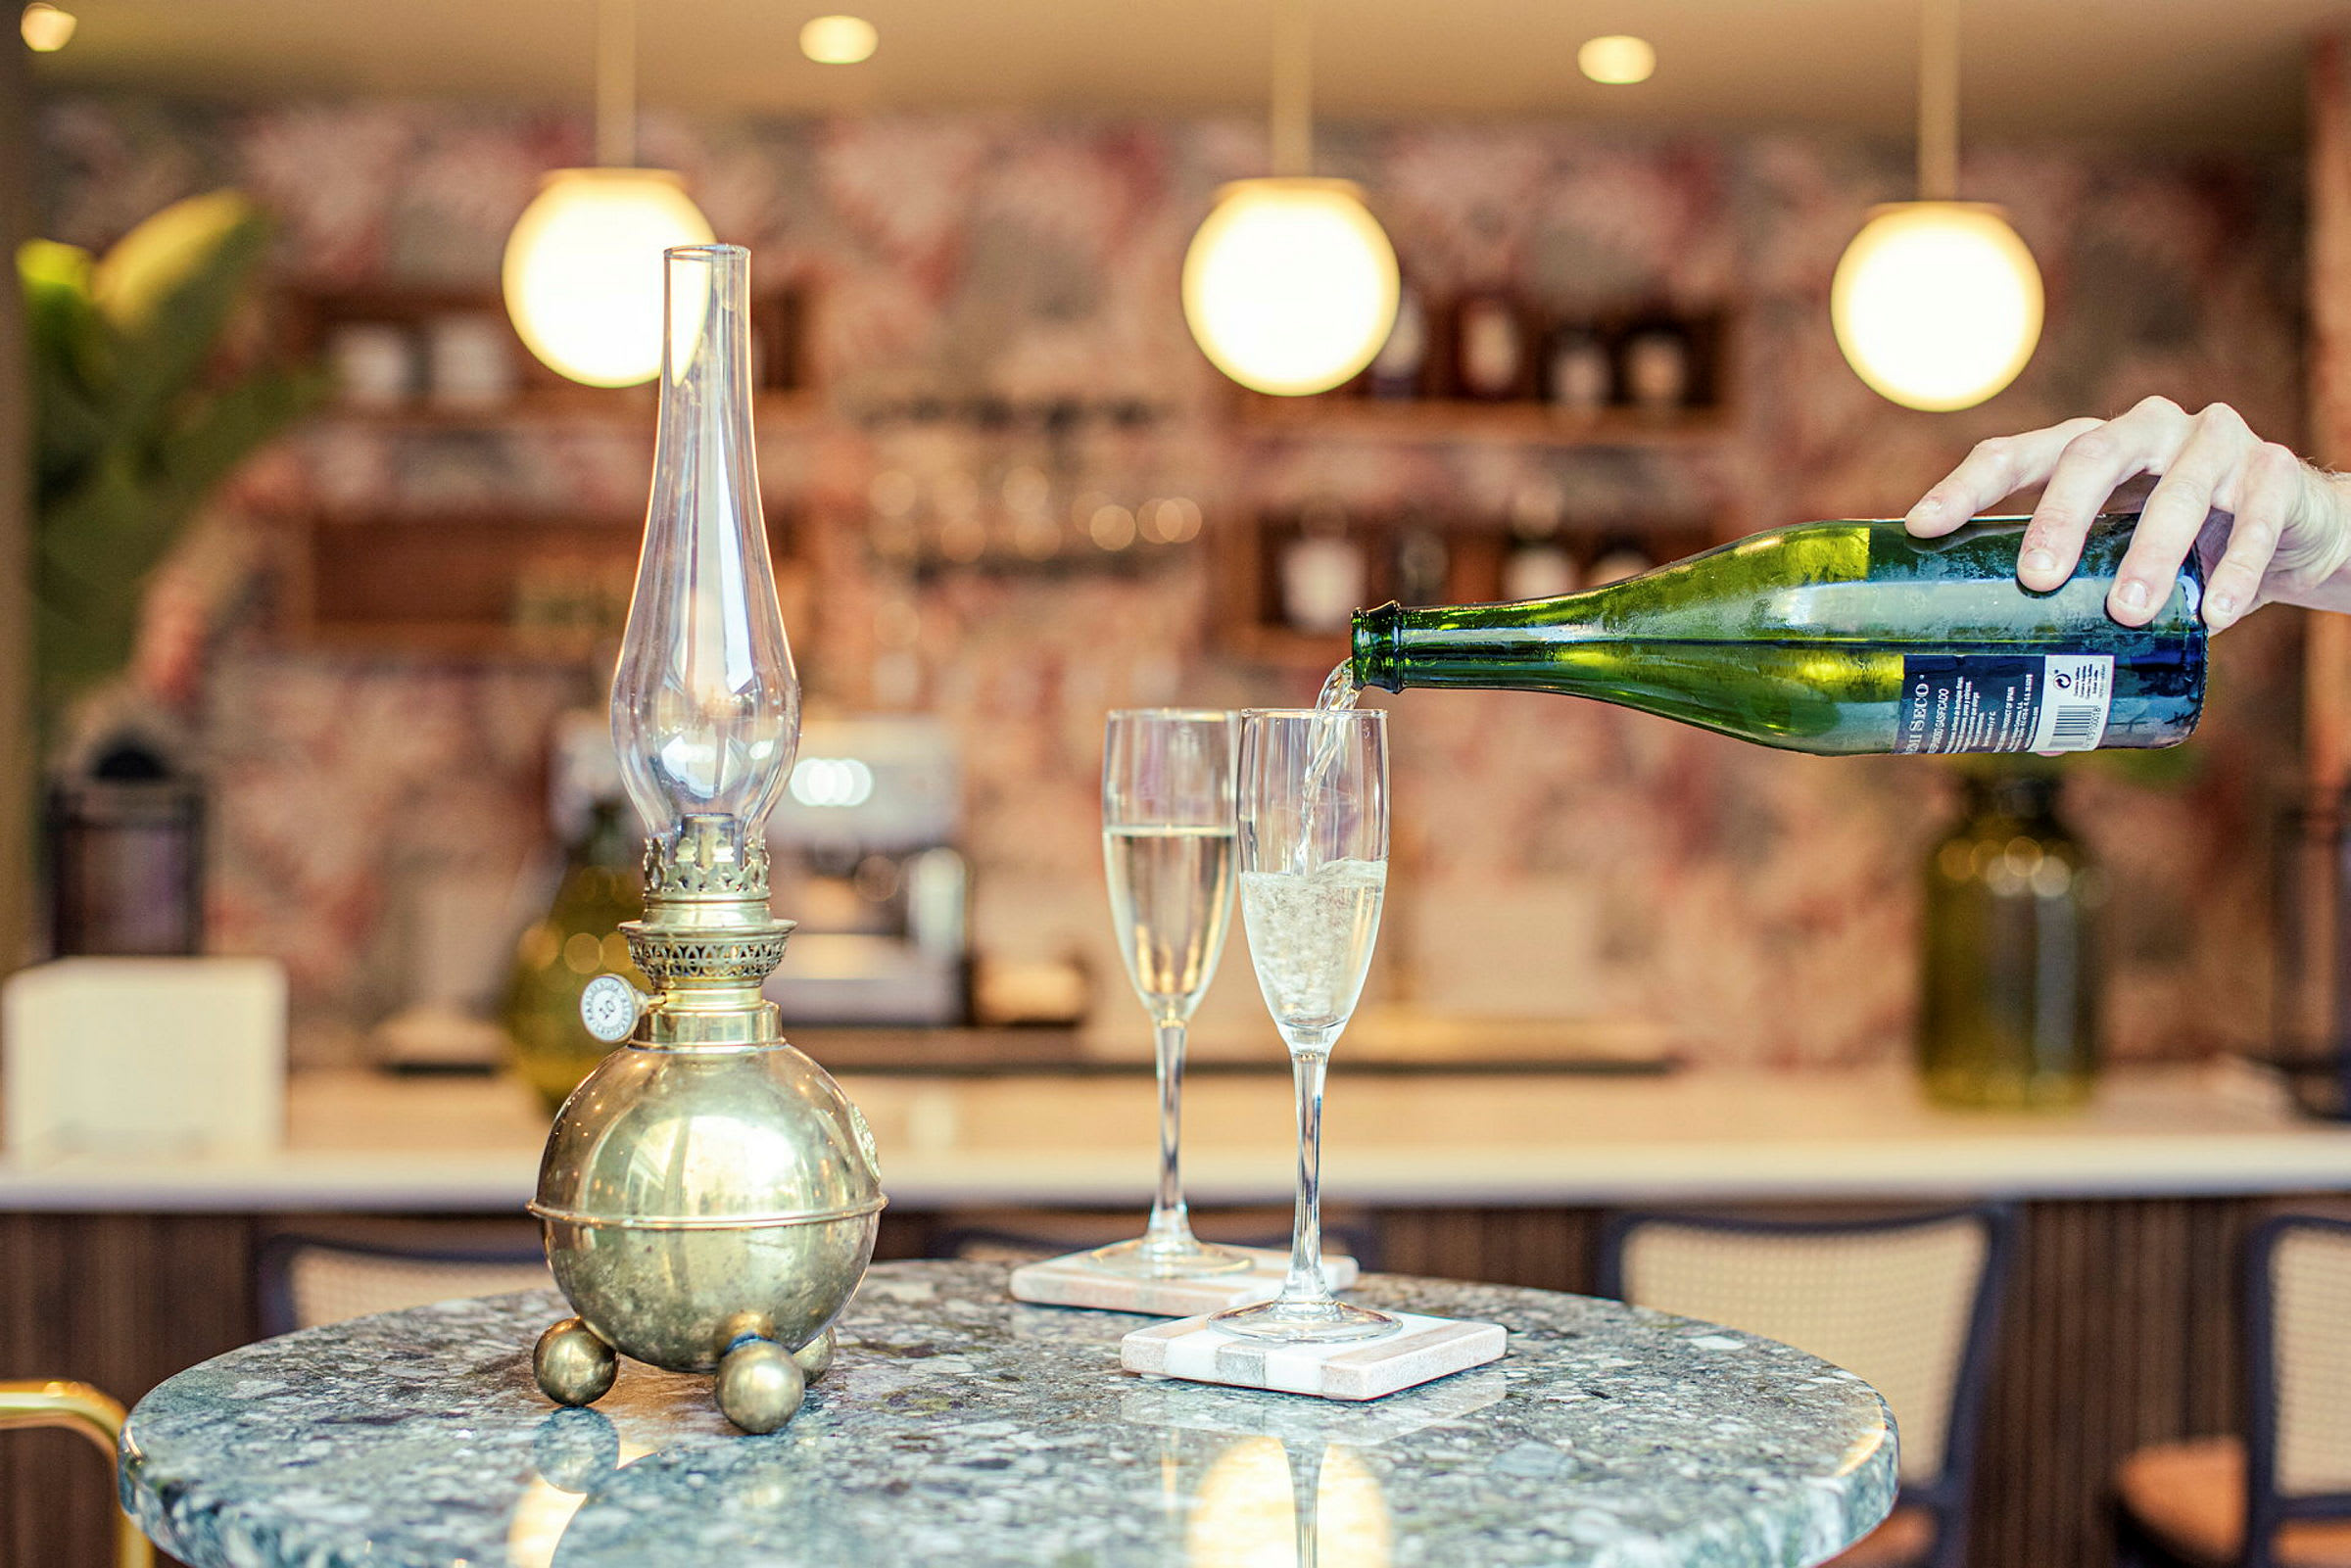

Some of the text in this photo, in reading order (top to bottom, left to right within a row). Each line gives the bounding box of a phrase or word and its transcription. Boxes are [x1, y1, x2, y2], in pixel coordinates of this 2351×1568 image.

[1905, 684, 1929, 754] EMI SECO
[1936, 689, 1949, 728] GASIFICADO
